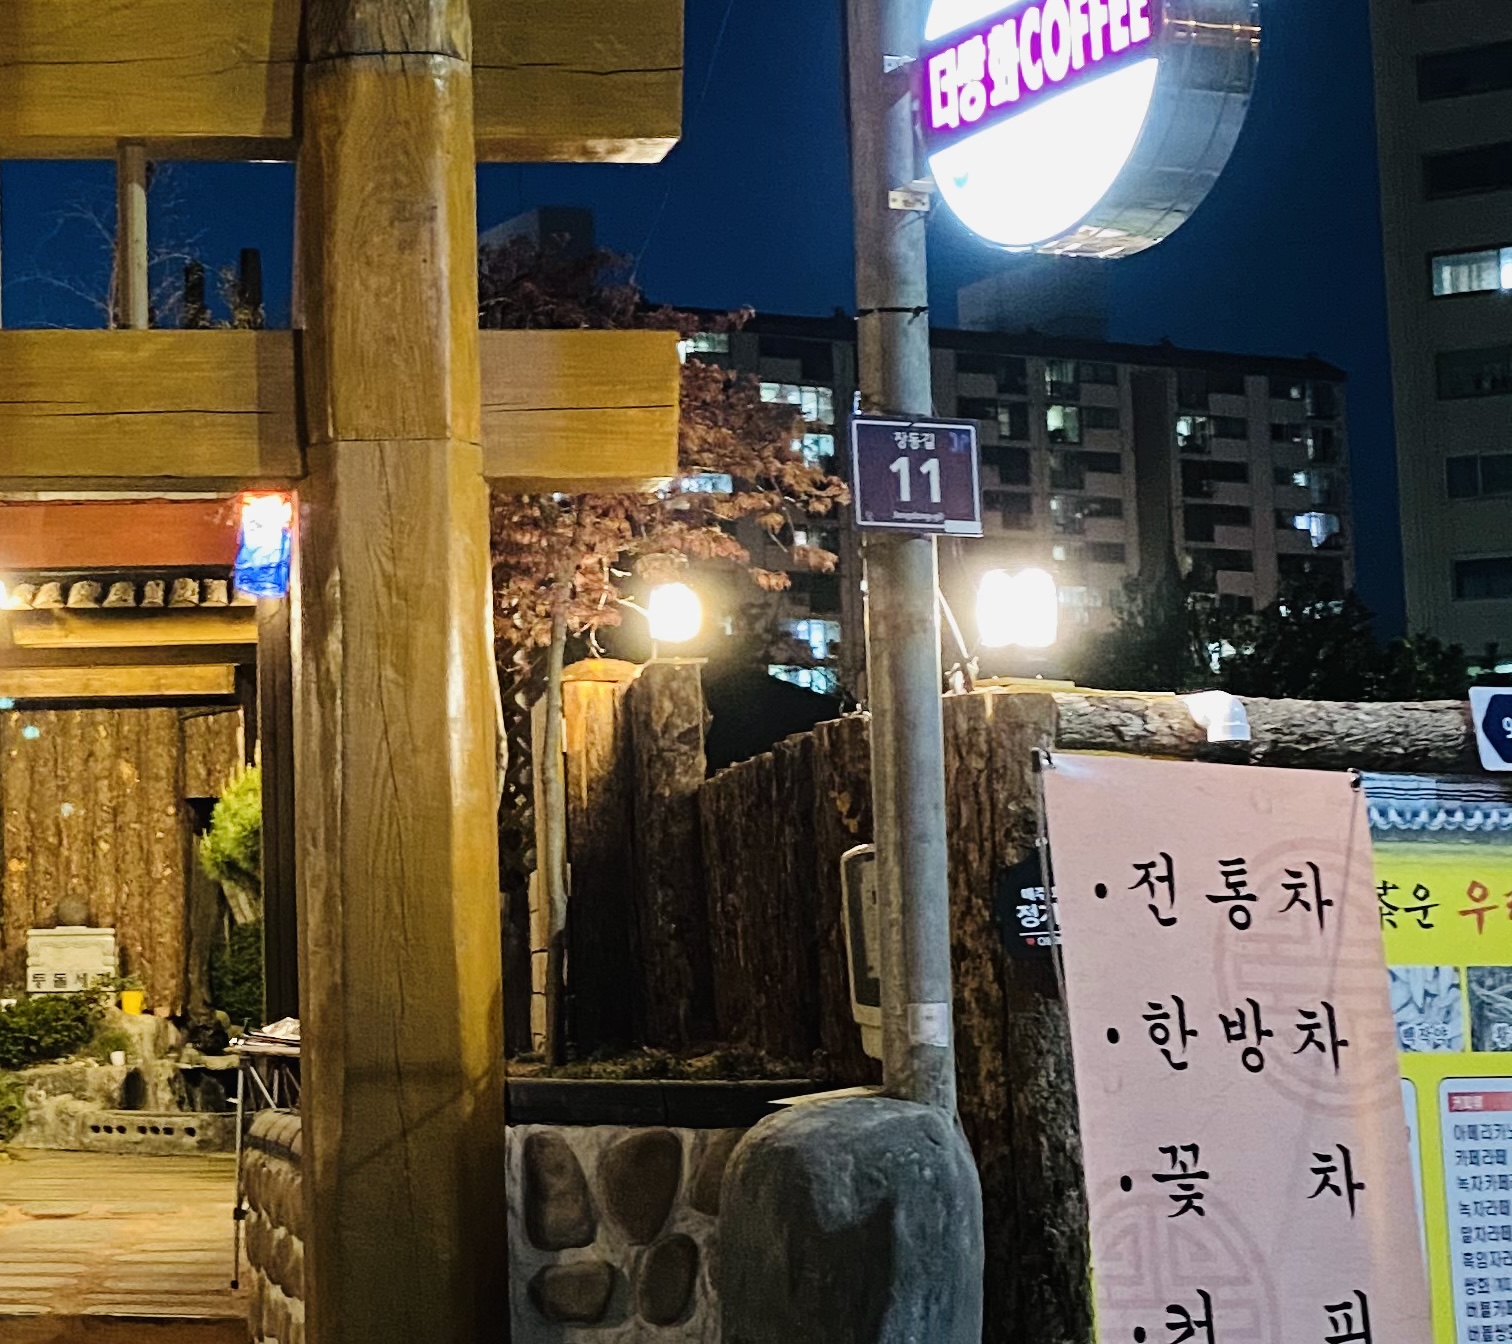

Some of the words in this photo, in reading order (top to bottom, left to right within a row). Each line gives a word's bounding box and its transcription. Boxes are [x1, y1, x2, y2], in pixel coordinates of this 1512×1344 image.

[889, 456, 941, 503] 11
[1126, 852, 1334, 931] 전통차
[1141, 995, 1350, 1076] 한방차
